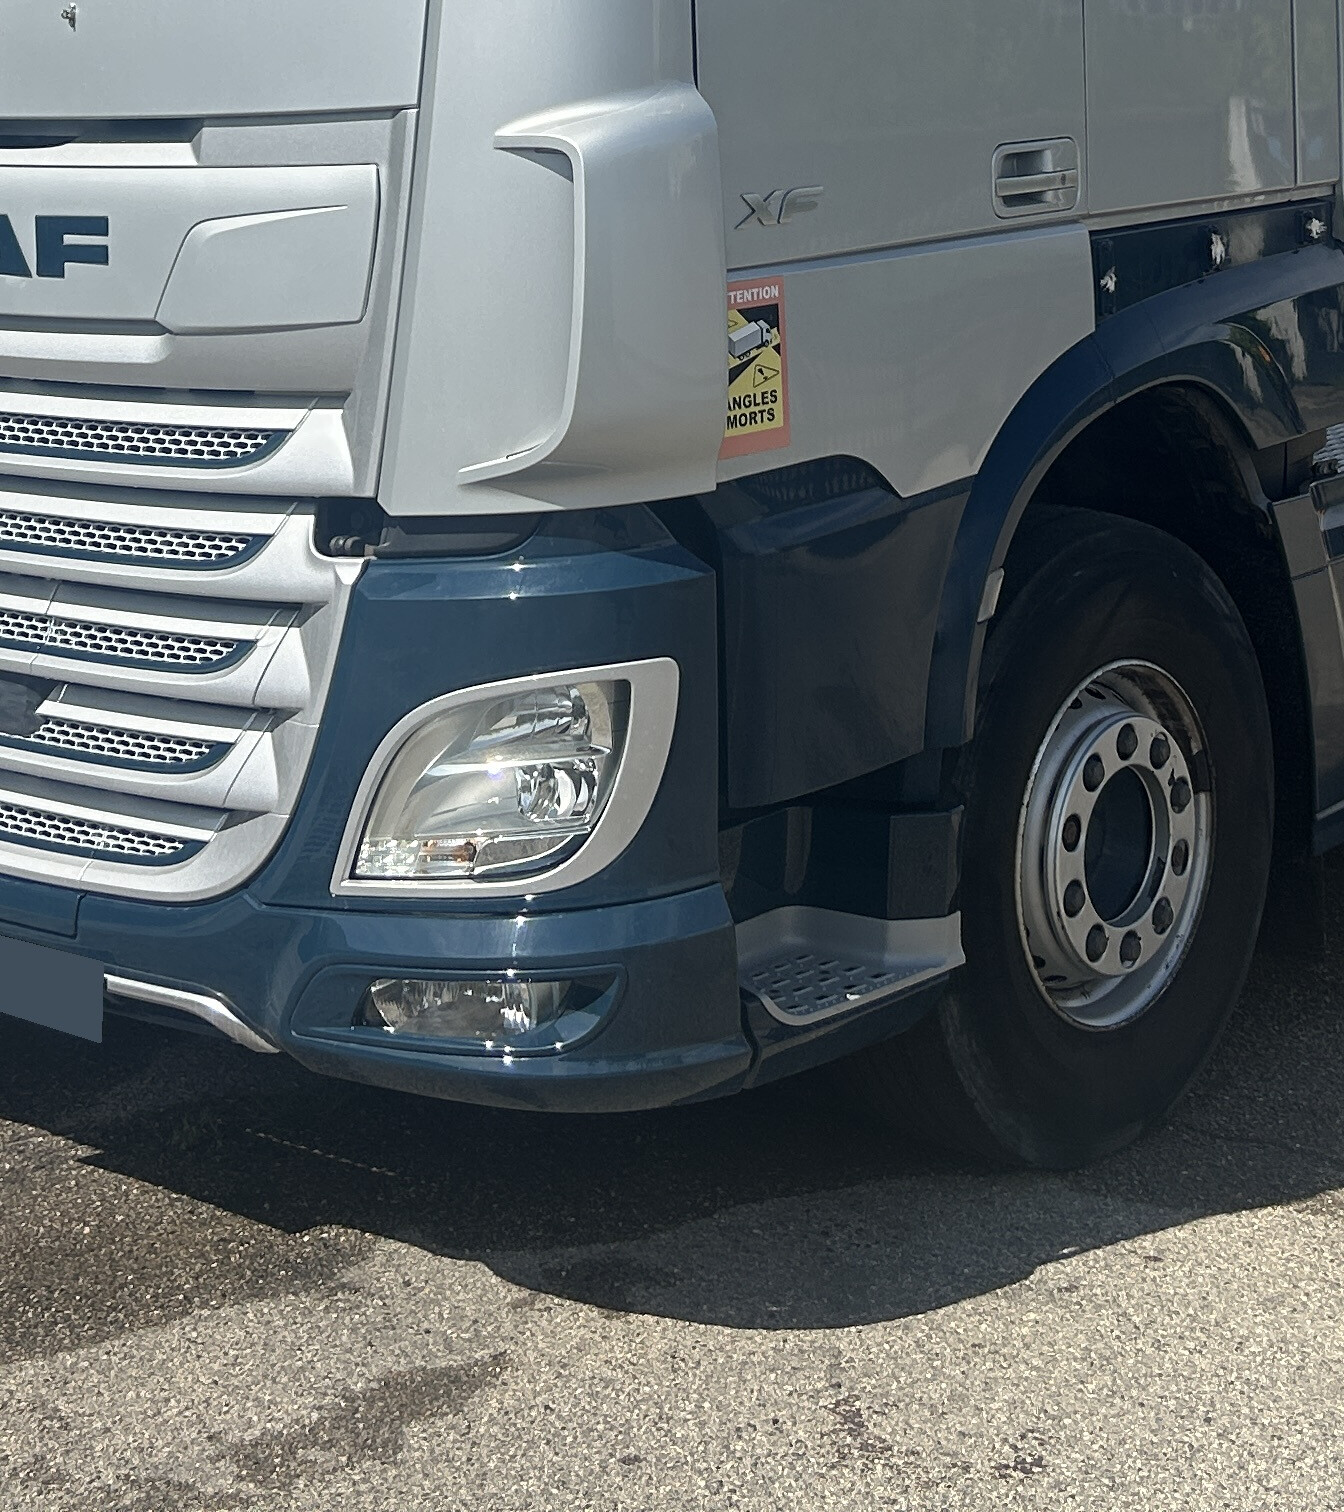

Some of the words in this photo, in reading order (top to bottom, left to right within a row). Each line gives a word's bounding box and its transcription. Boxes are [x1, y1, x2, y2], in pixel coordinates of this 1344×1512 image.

[734, 185, 824, 231] XF
[727, 285, 779, 305] TENTION
[726, 407, 776, 430] MORTS
